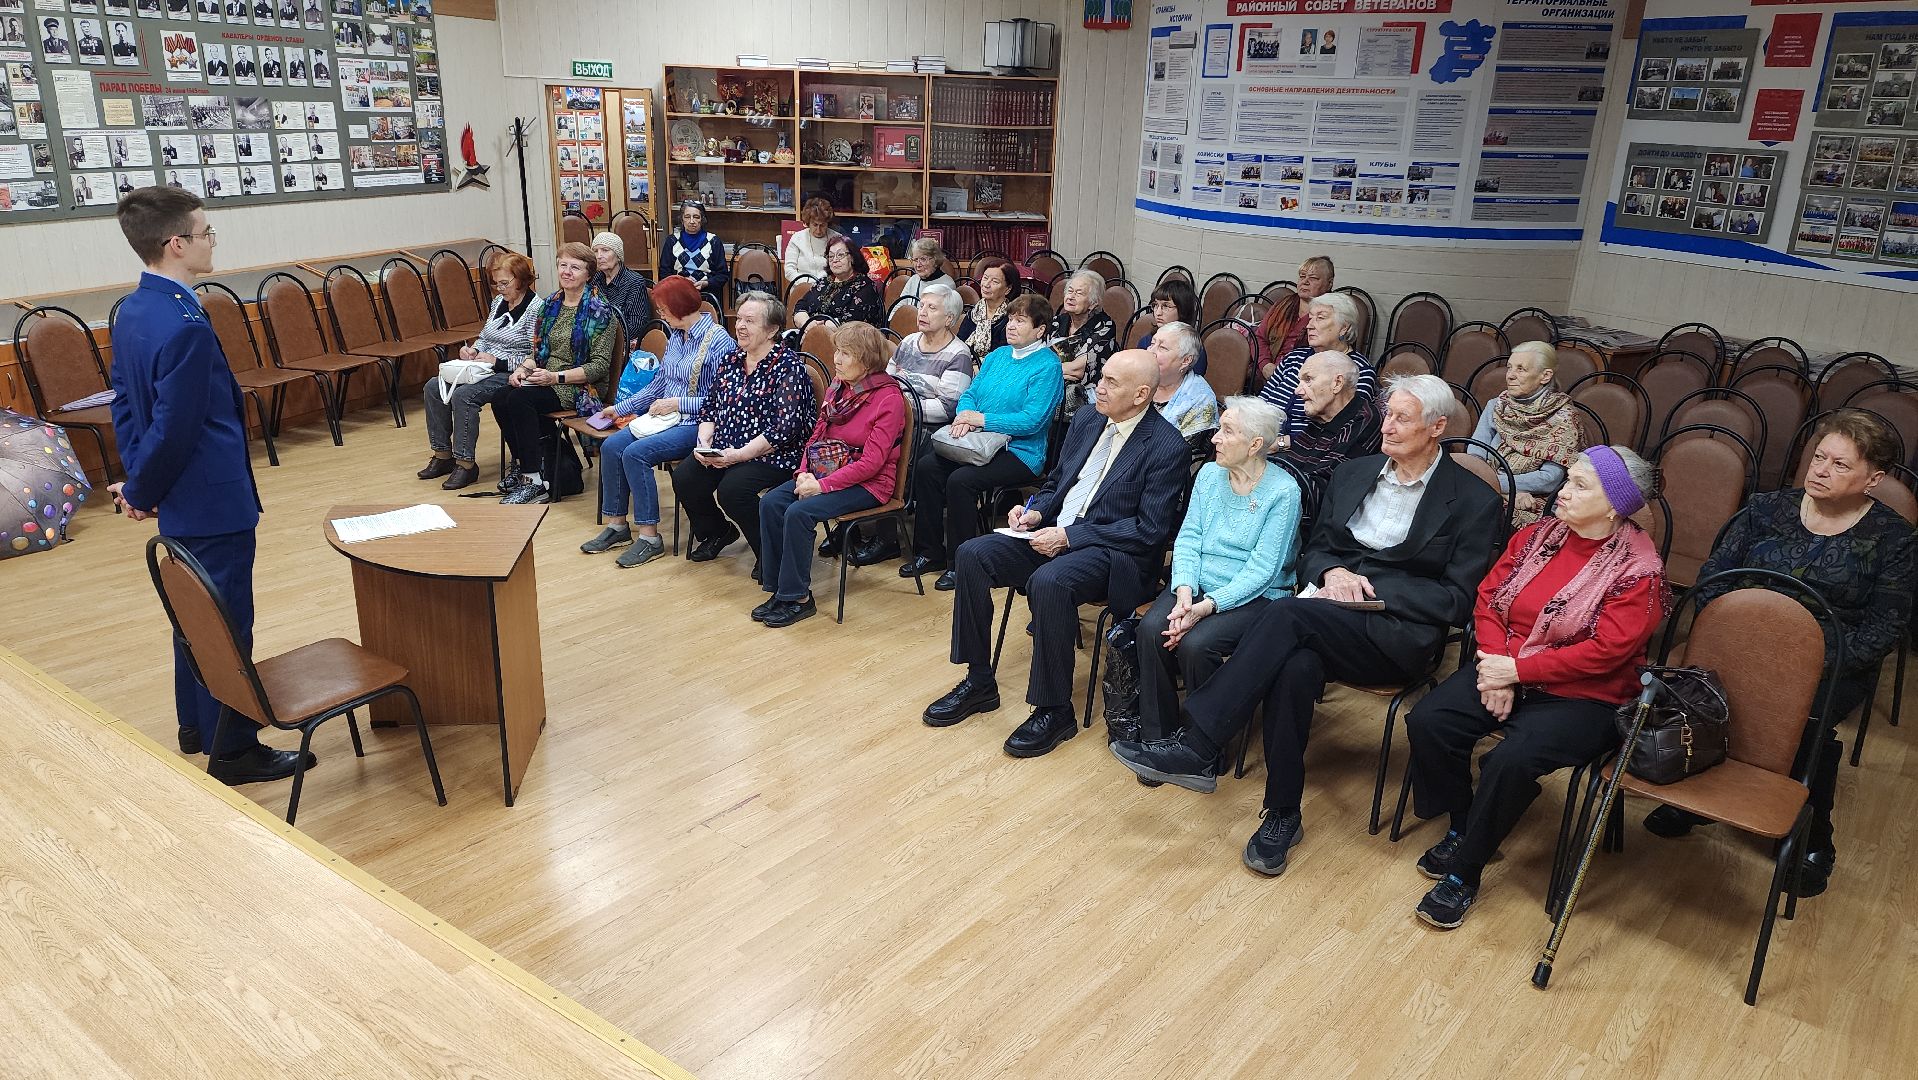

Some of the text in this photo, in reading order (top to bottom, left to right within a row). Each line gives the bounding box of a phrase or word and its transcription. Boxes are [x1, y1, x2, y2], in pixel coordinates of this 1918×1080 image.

[1236, 0, 1437, 12] РАЙОННЫЙ СОВЕТ ВЕТЕРАНОВ
[1541, 8, 1615, 18] ОРГАНИЗАЦИИ
[575, 62, 610, 77] ВЫХОД
[100, 82, 128, 94] ПАРАД
[128, 83, 163, 94] ПОБЕДЫ
[1284, 86, 1335, 94] НАПРАВЛЕНИЯ
[1336, 87, 1396, 95] ДЕЯТЕЛЬНОСТИ
[1660, 150, 1670, 158] ДО
